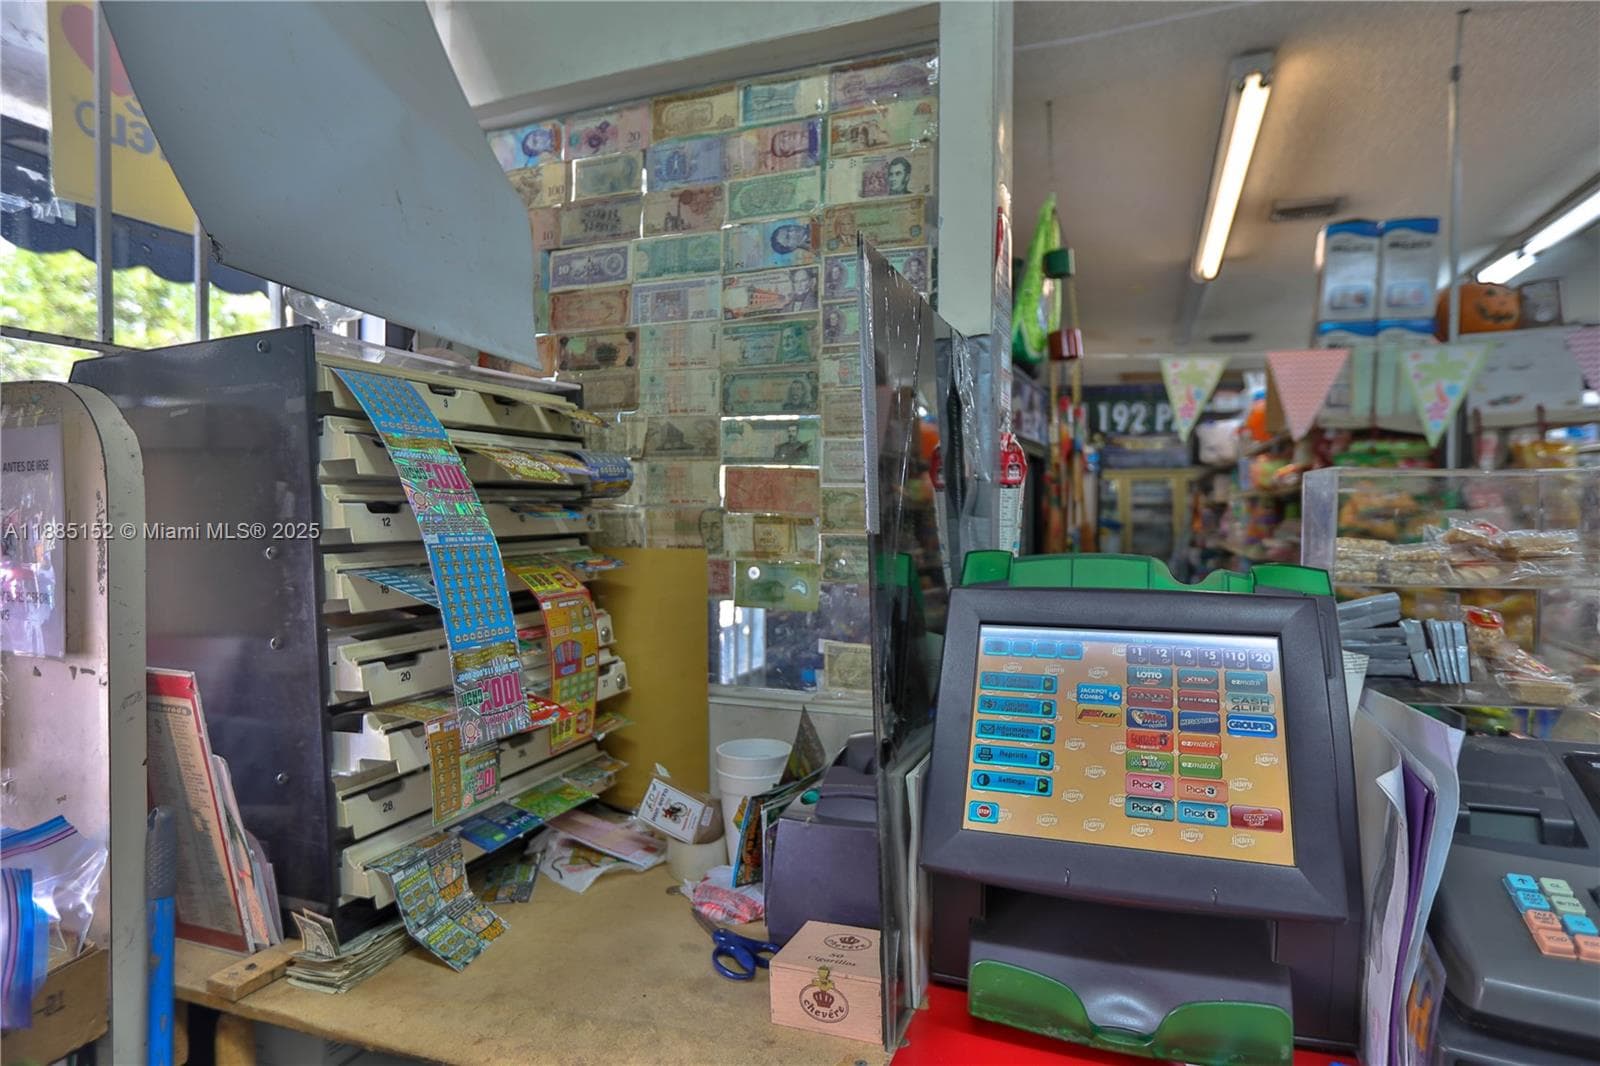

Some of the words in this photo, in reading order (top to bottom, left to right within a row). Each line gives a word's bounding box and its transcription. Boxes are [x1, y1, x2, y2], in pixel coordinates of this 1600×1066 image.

[443, 399, 449, 408] 3
[1097, 401, 1148, 434] 192
[3, 460, 25, 472] ANTES
[27, 460, 35, 472] DE
[36, 459, 49, 471] IRSE
[382, 517, 391, 527] 12
[1226, 652, 1246, 662] $10
[1251, 653, 1271, 662] $20
[400, 670, 411, 682] 20
[1136, 671, 1163, 680] LOTTO
[1108, 691, 1120, 701] $6
[1229, 721, 1271, 731] GROUPER
[1181, 740, 1216, 749] ezmatch
[1181, 761, 1216, 770] ezmatch
[998, 776, 1026, 785] Settings
[382, 800, 394, 812] 28
[807, 955, 856, 967] Cigarillos
